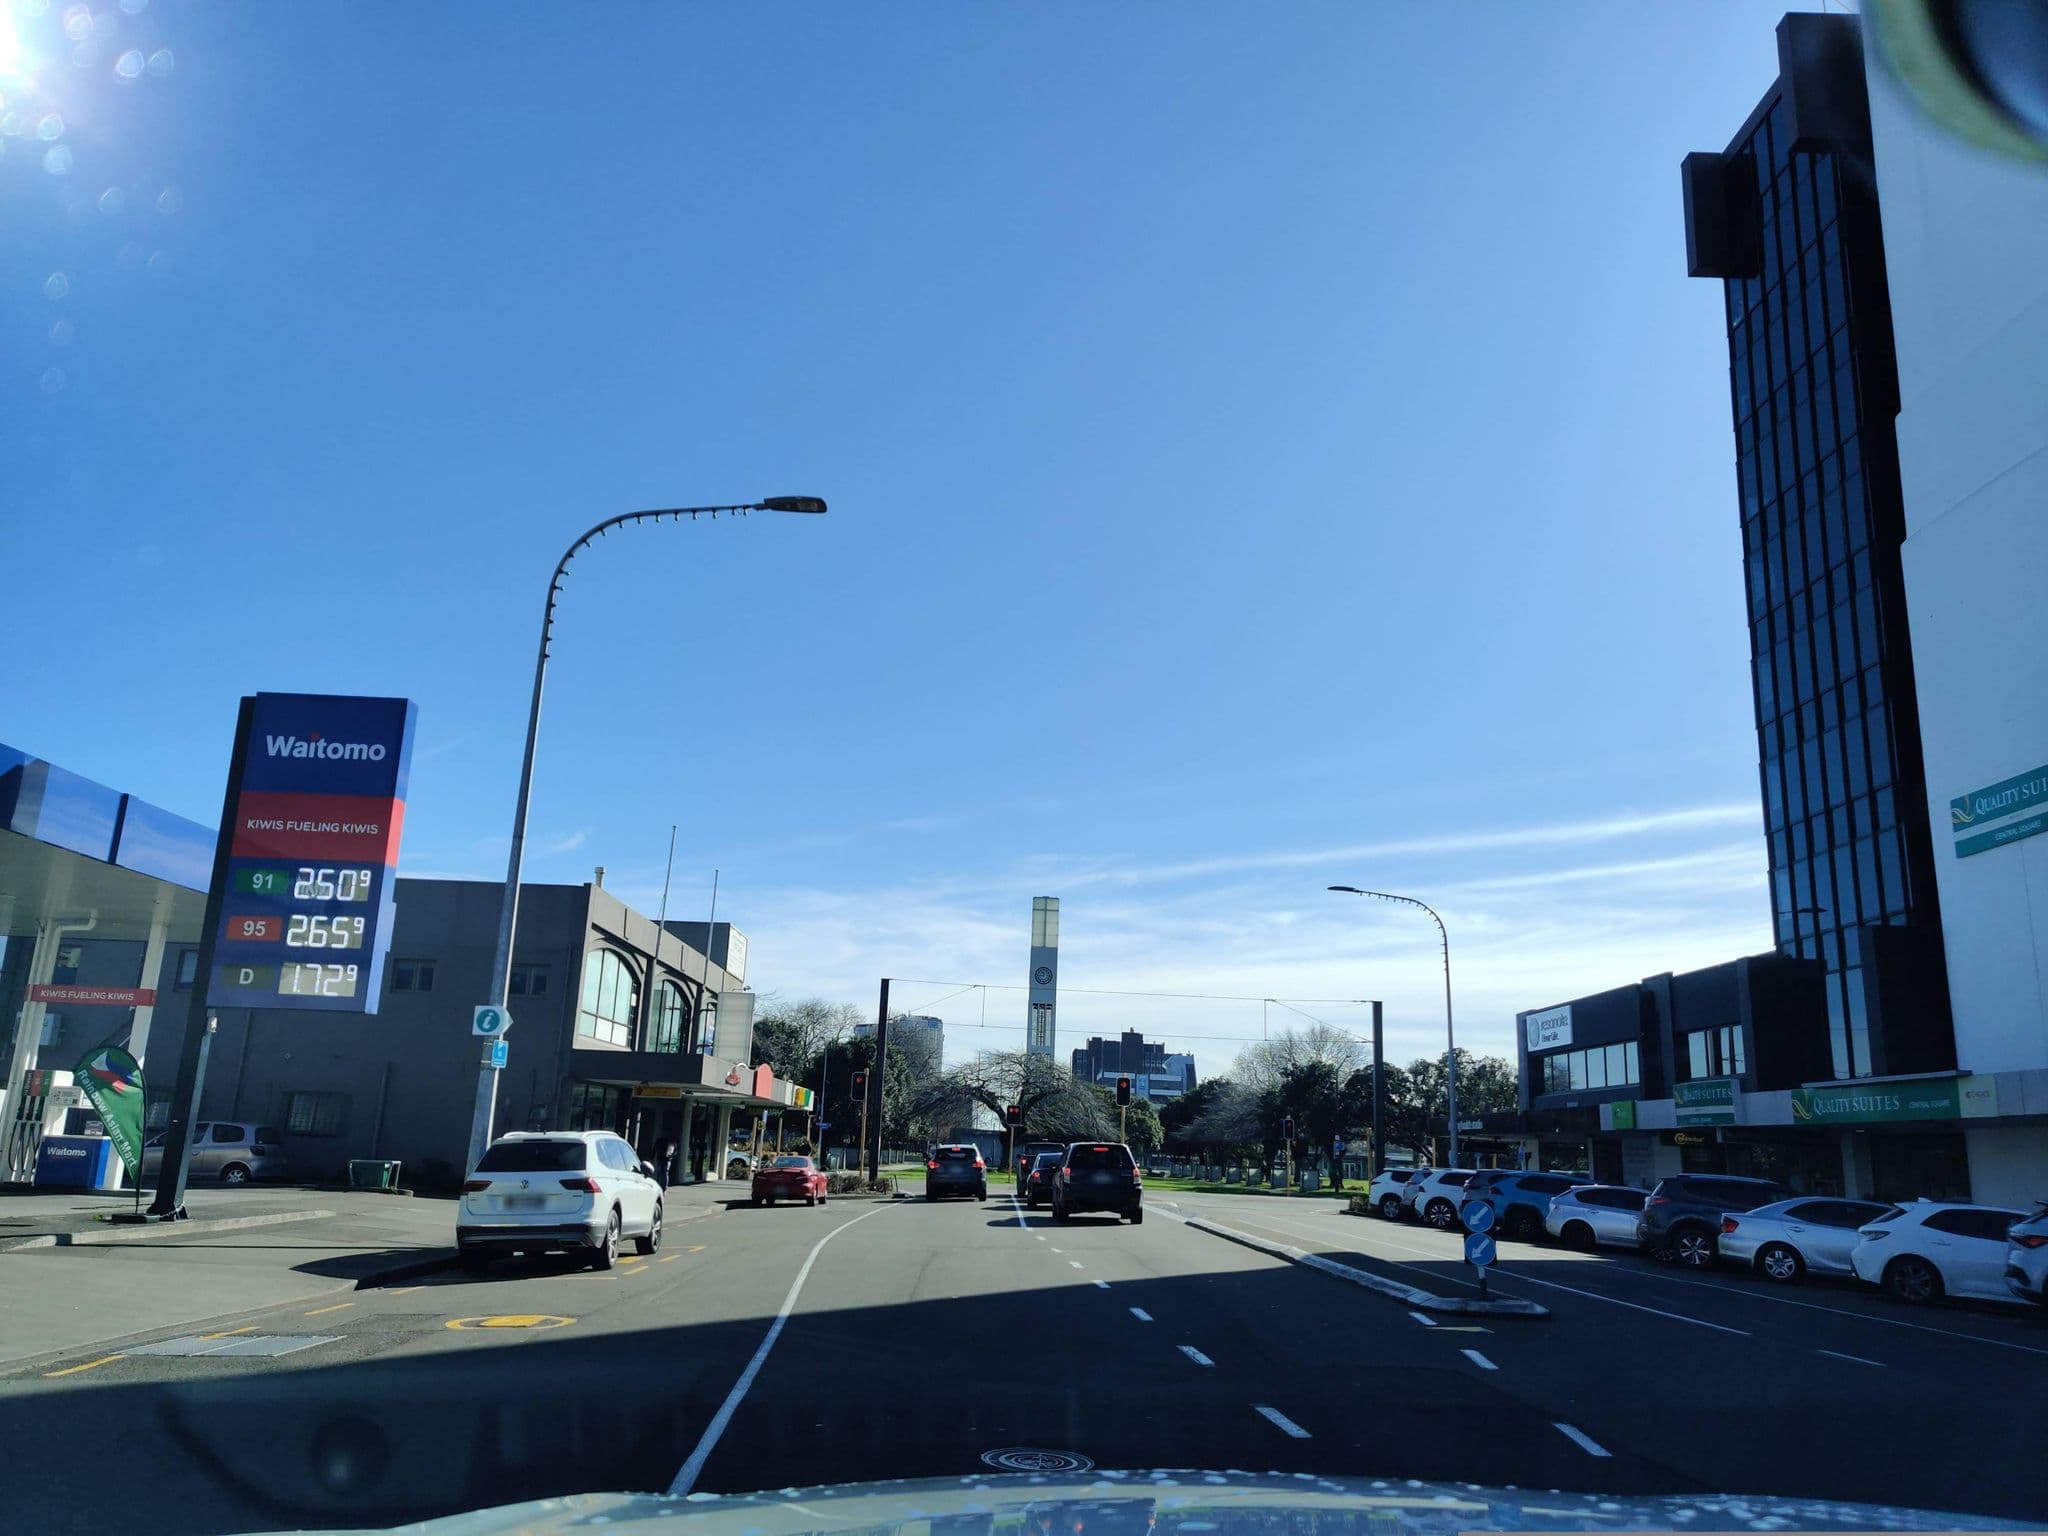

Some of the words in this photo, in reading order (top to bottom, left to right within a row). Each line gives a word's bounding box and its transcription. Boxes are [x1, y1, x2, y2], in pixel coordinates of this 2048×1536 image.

[265, 732, 386, 761] Waitomo
[1975, 787, 2019, 815] QUALITY
[2022, 777, 2048, 799] SUI
[247, 819, 284, 831] KIWIS
[286, 821, 340, 833] FUELING
[342, 823, 379, 835] KIWIS
[252, 873, 273, 889] 91
[243, 920, 266, 936] 95
[238, 968, 254, 985] D
[40, 990, 67, 998] KIWIS
[68, 990, 107, 1000] FUELING
[107, 992, 135, 1001] KIWIS
[1813, 1096, 1850, 1115] QUALITY
[1851, 1095, 1900, 1111] SUITES
[79, 1069, 108, 1115] Rainbow
[103, 1113, 123, 1142] Asian
[119, 1140, 138, 1167] Mart
[47, 1147, 87, 1157] Waitomo
